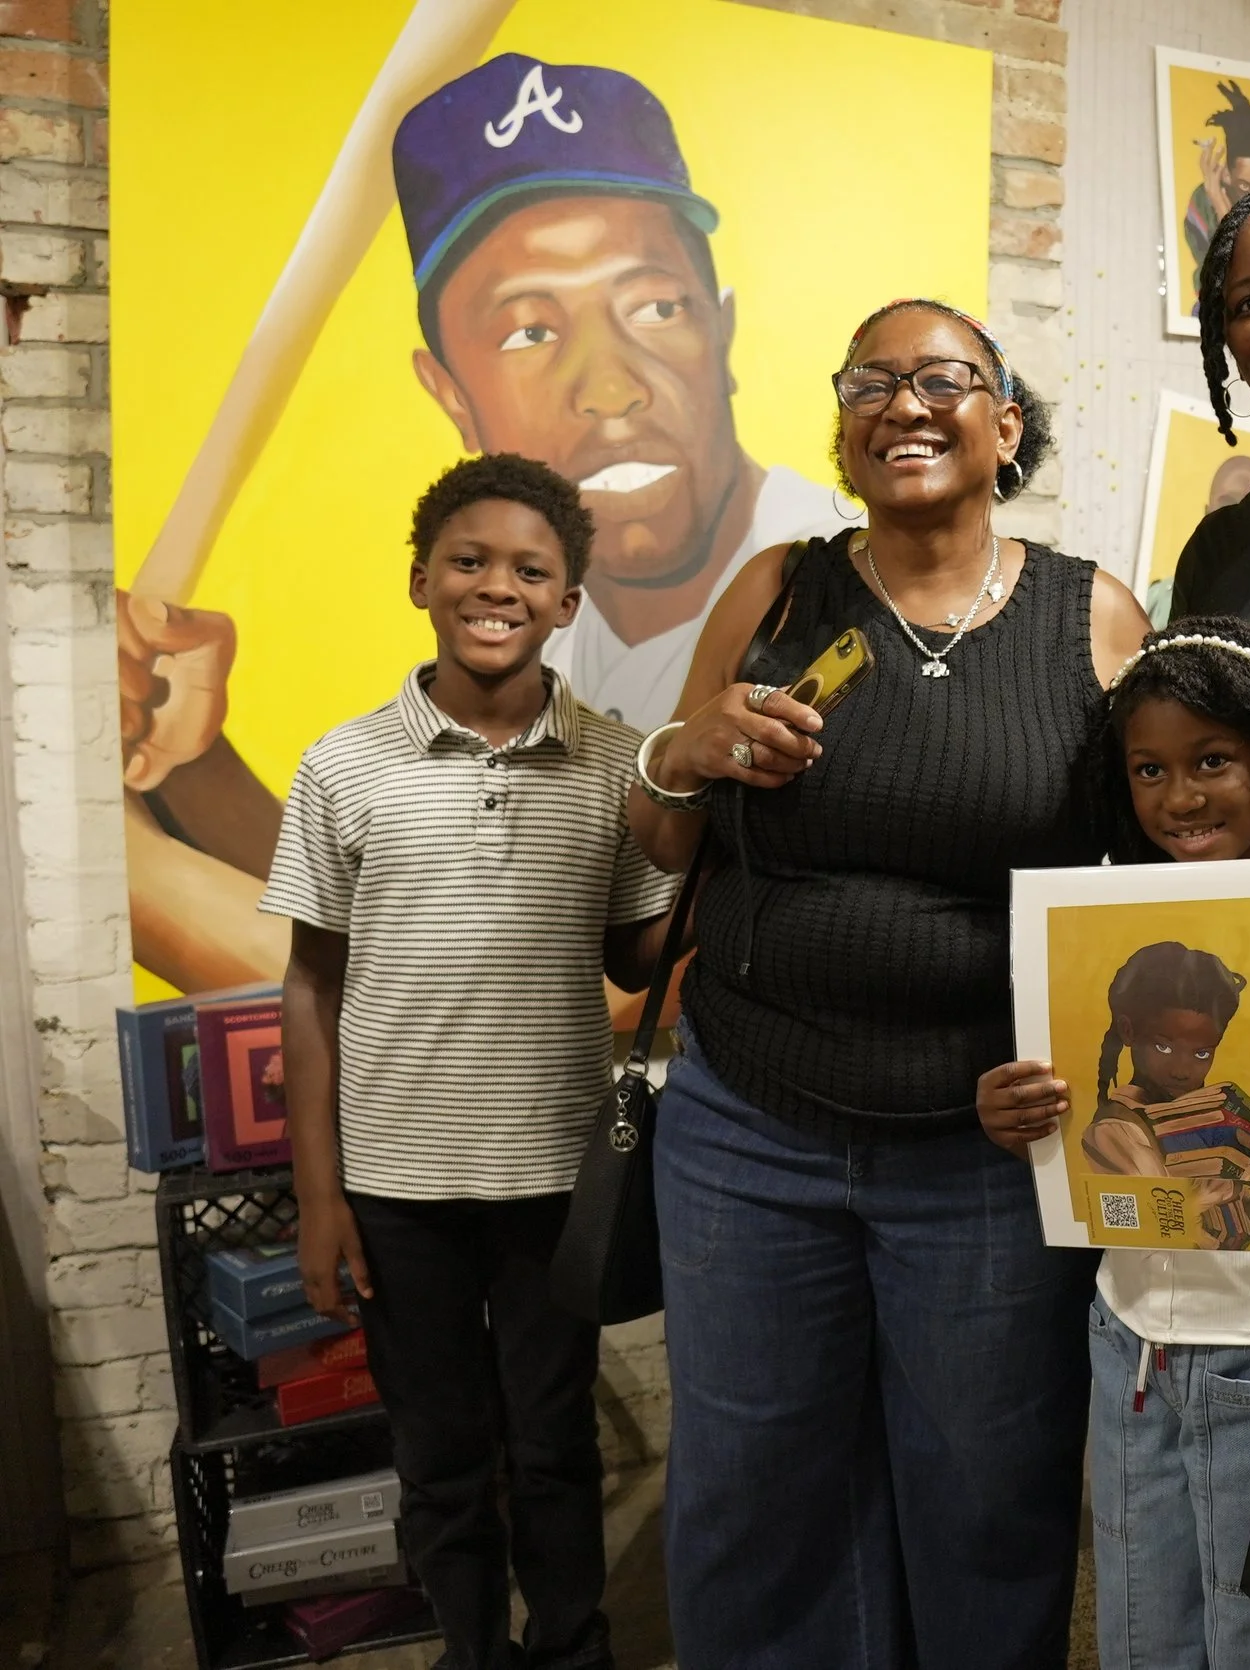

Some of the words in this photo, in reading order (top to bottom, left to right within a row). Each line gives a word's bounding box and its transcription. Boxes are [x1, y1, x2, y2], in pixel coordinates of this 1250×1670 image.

[485, 65, 583, 148] A
[1151, 1187, 1171, 1238] CULTURE
[1167, 1190, 1185, 1235] CHEERS
[249, 1559, 298, 1580] CHEERS
[321, 1544, 377, 1566] CULTURE
